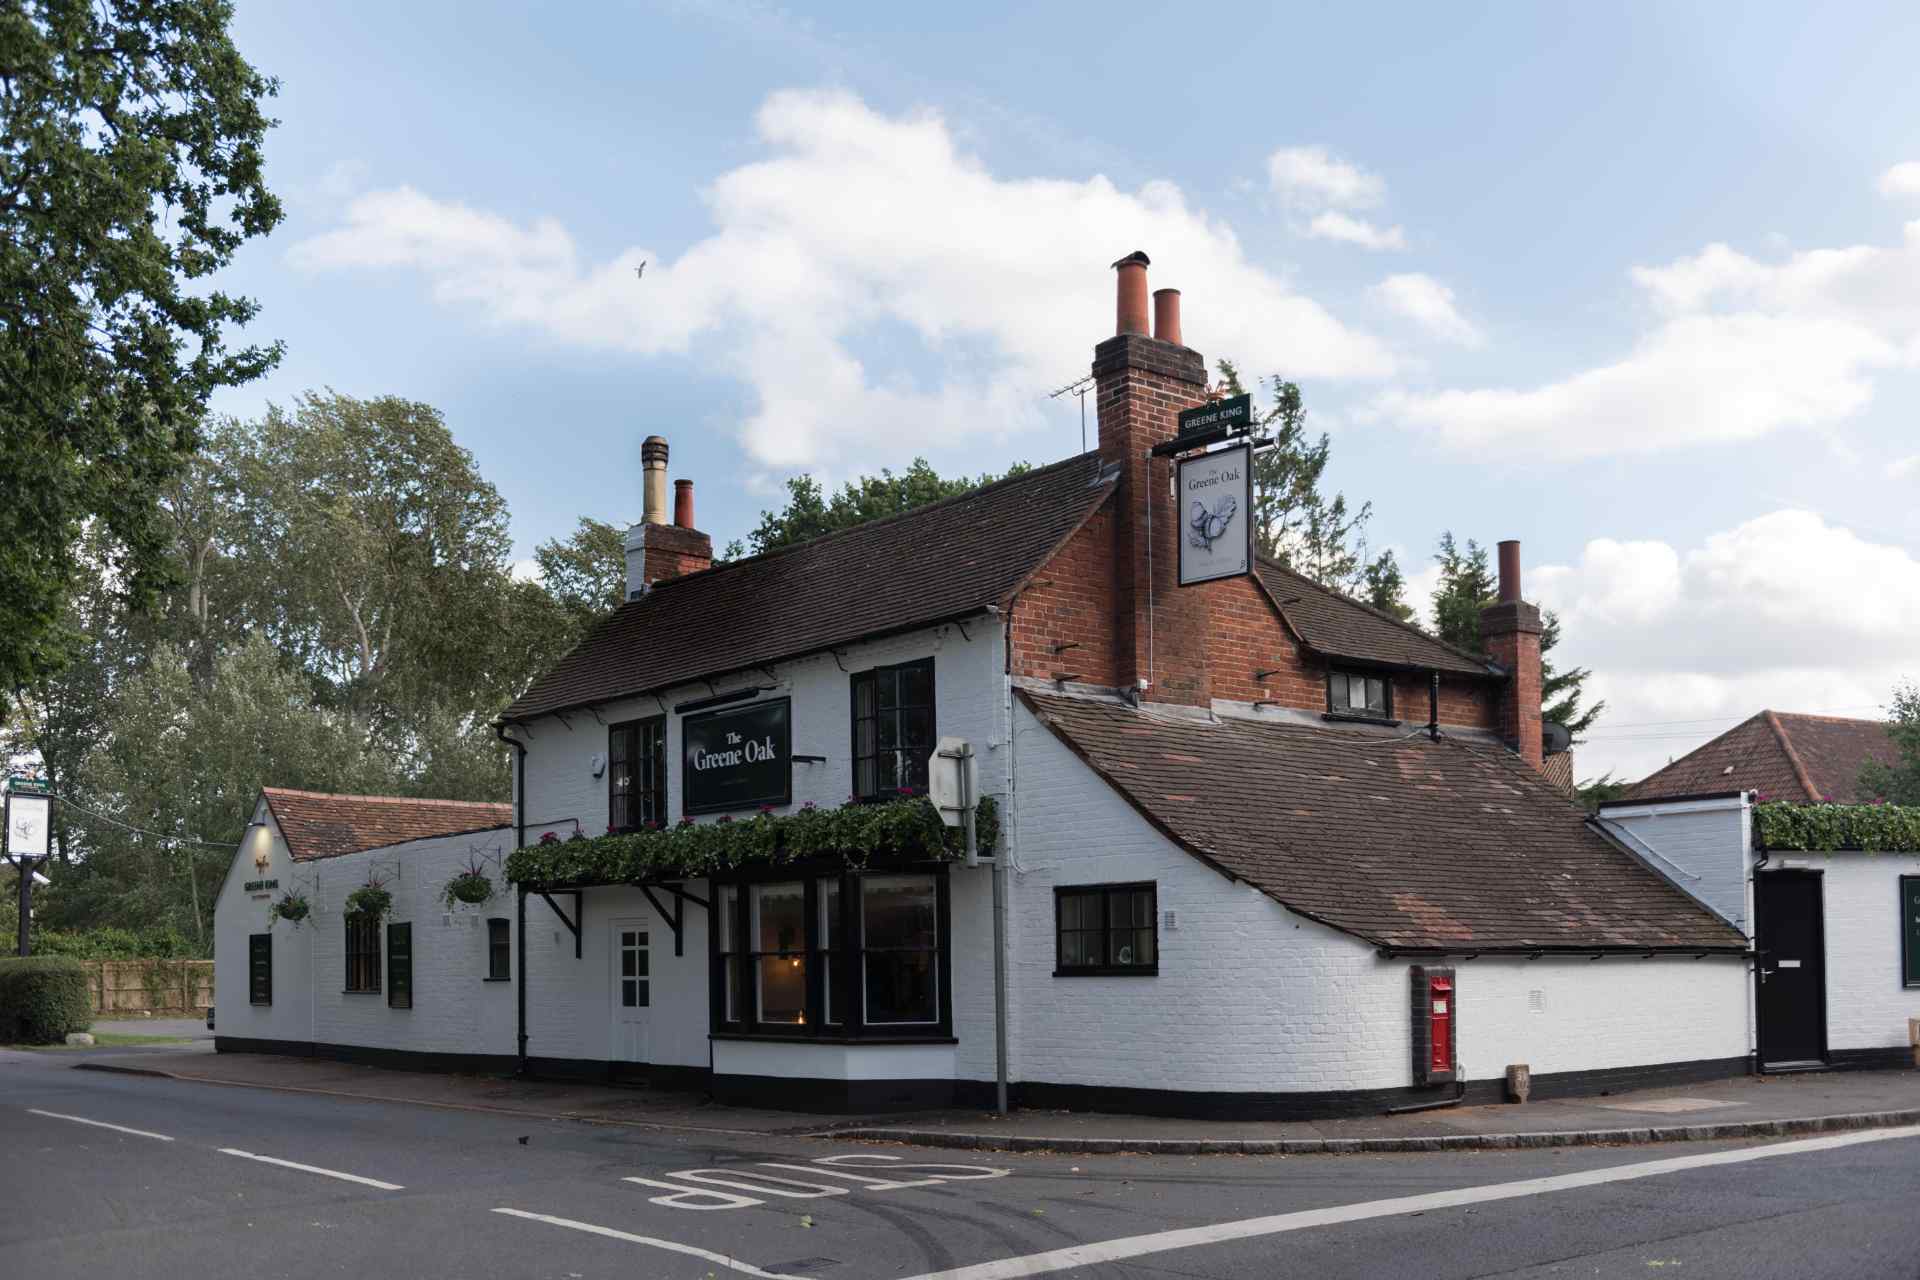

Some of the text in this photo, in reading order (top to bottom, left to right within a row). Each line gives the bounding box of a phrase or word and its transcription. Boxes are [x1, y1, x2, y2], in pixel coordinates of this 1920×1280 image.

[1184, 413, 1218, 429] GREENE
[1219, 406, 1242, 419] KING
[1188, 476, 1220, 490] Greene
[1220, 467, 1241, 482] Oak
[726, 732, 741, 745] The
[694, 736, 776, 771] Greene Oak
[621, 1154, 1013, 1210] STOP
